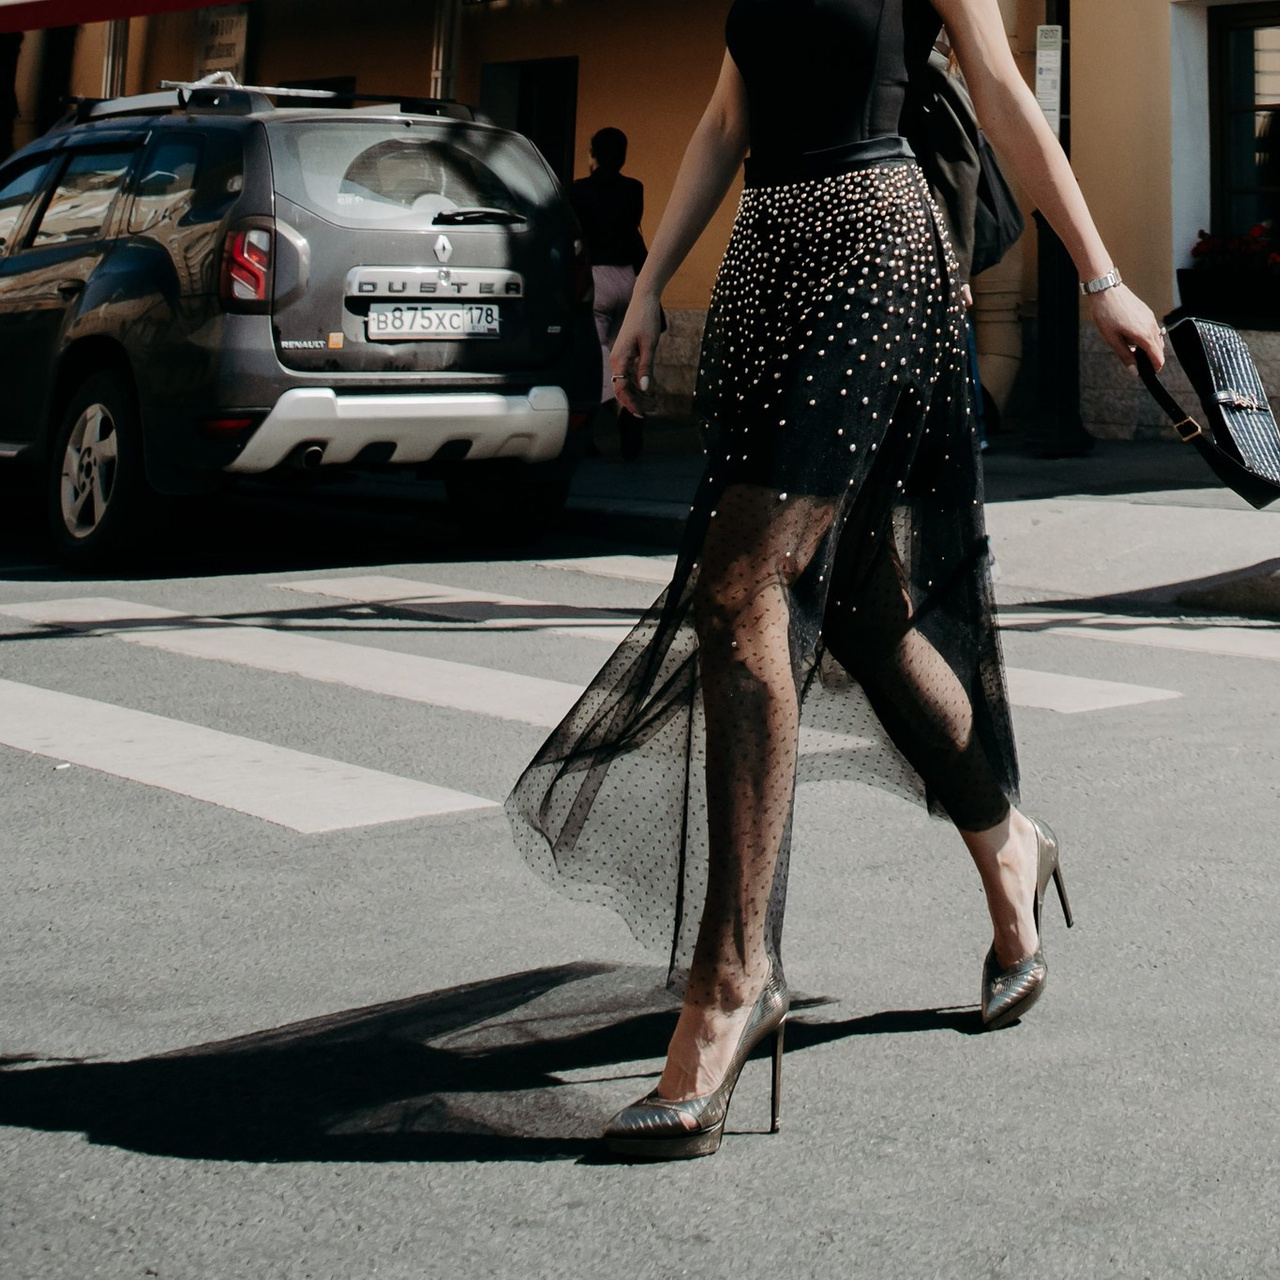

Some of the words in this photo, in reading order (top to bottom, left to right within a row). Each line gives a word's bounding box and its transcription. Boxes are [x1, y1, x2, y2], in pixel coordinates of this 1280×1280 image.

[358, 281, 521, 294] DUSTER
[466, 306, 495, 325] 178
[280, 340, 326, 349] RENAULT
